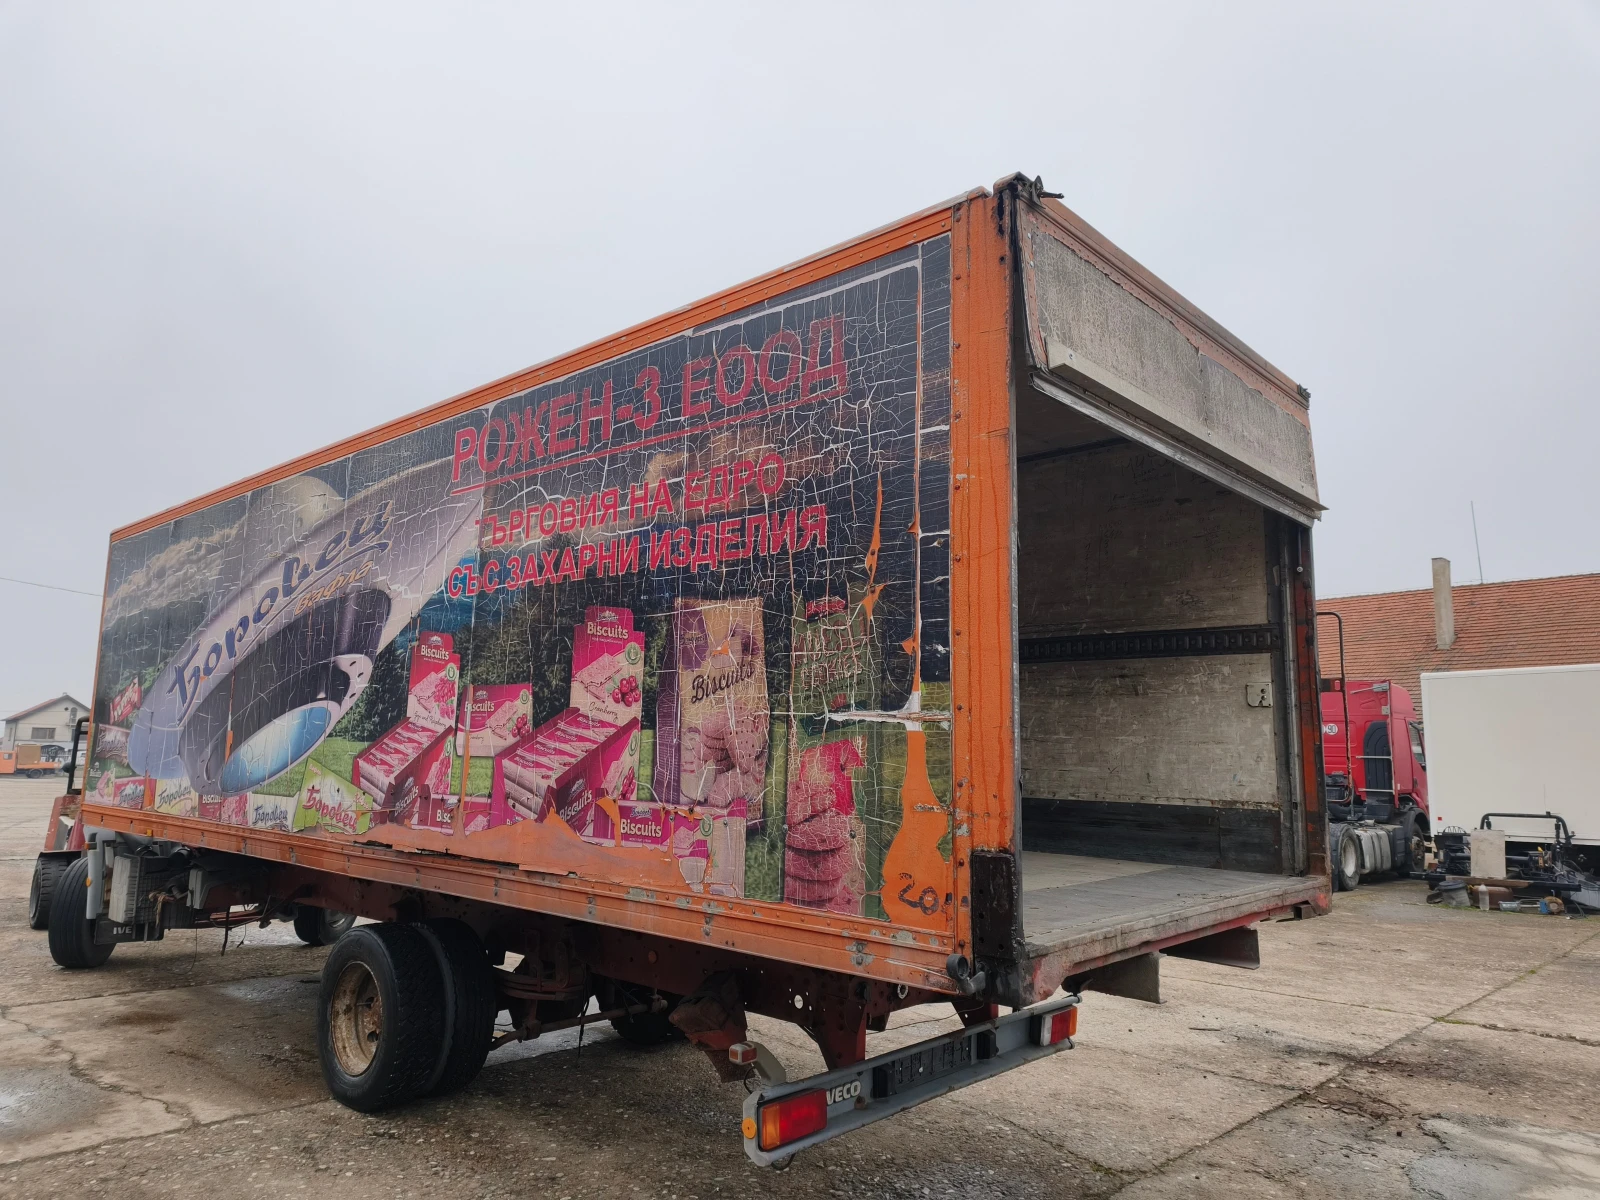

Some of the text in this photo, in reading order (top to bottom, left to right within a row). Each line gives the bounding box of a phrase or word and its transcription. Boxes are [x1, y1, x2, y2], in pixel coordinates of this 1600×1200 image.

[680, 312, 848, 418] ЕООД
[475, 453, 786, 547] ТЪРГОВИЯ НА ЕДРО
[447, 504, 828, 599] СЪС ЗАХАРНИ ИЗДЕЛИЯ
[587, 621, 629, 640] Biscuits
[421, 645, 450, 661] Biscuits
[691, 657, 755, 704] Biscuits
[464, 700, 495, 712] Bscuits
[588, 701, 619, 723] Cranberry
[560, 789, 593, 821] Biscuits
[620, 818, 662, 838] Biscuits
[826, 1080, 861, 1105] VECO
